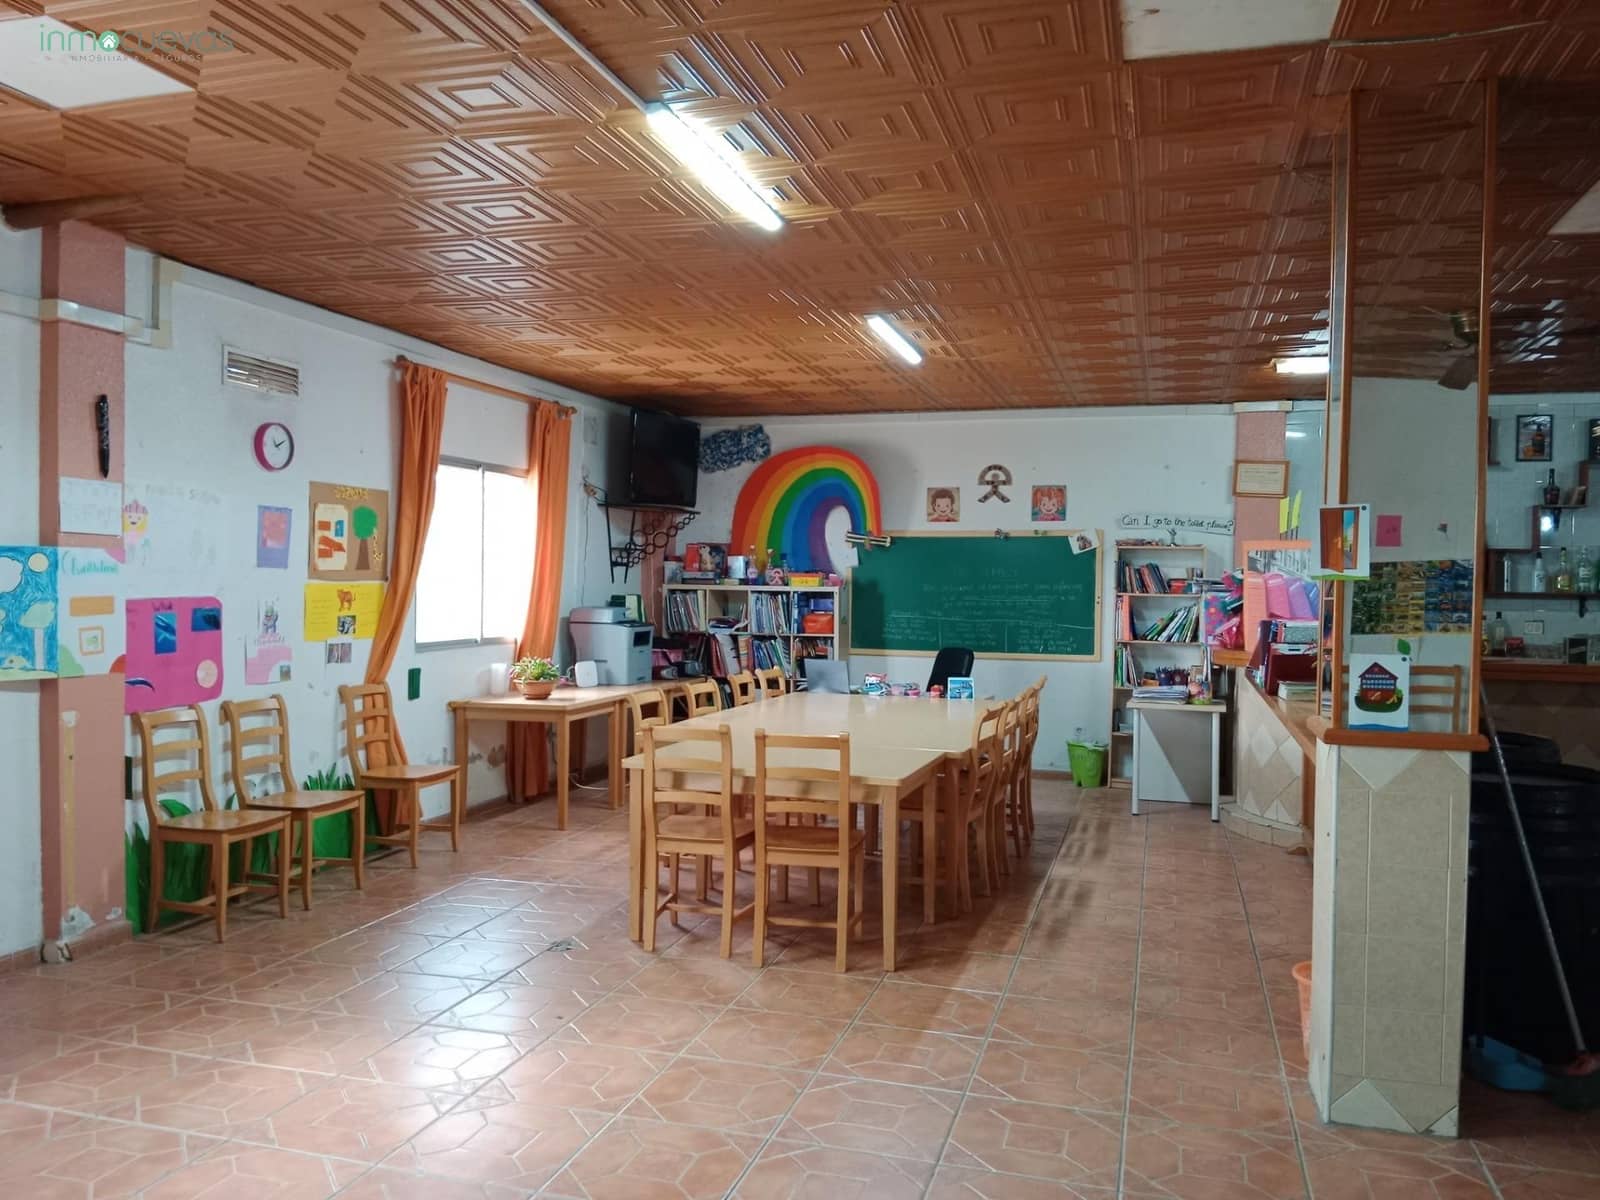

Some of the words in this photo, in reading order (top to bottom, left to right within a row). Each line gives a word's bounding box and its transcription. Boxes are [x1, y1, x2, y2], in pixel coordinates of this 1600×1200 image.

[1122, 515, 1139, 526] Can
[1144, 514, 1150, 526] I
[1153, 519, 1162, 528] go
[1163, 518, 1173, 526] to
[1174, 518, 1187, 527] the
